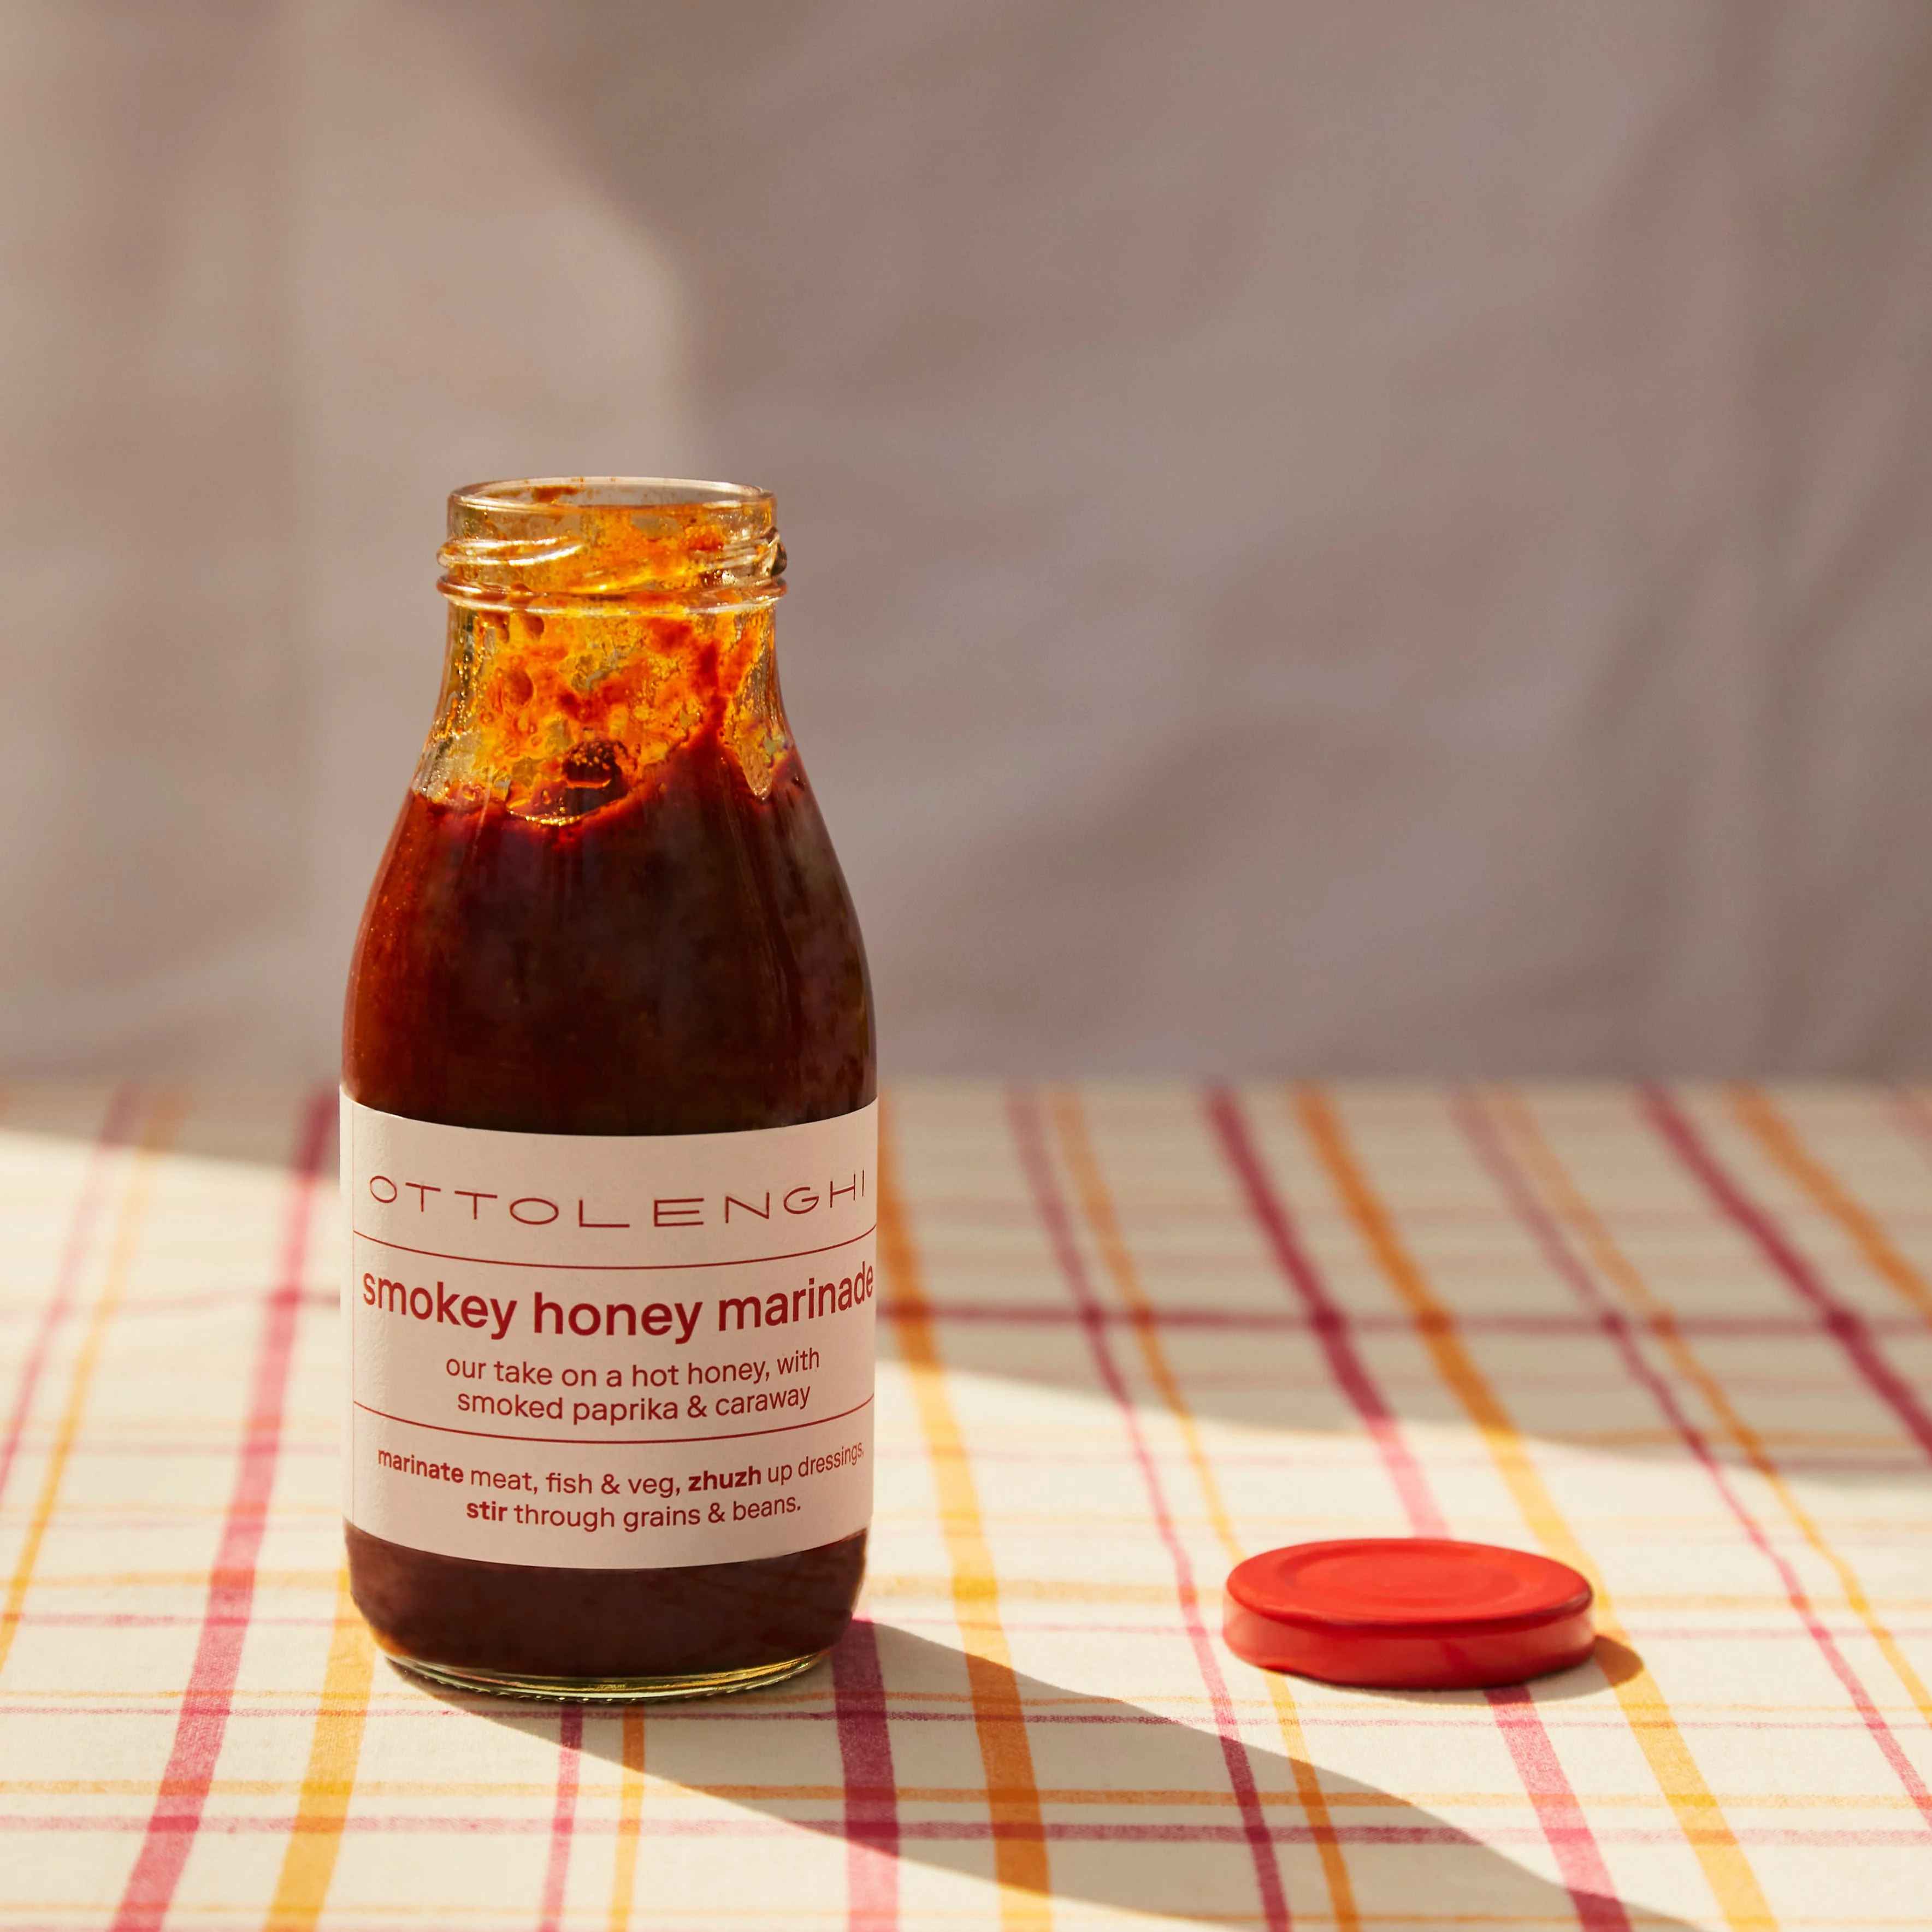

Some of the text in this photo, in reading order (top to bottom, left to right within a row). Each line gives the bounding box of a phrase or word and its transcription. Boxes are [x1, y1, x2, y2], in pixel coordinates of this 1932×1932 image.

[369, 1169, 865, 1228] OTTOLENGHI
[363, 1261, 873, 1345] smokey honey marinade
[446, 1347, 819, 1388] our take on a hot honey, with
[457, 1385, 811, 1426] smoked paprika & caraway
[378, 1449, 464, 1484] marinate
[470, 1469, 538, 1495] meat,
[545, 1472, 593, 1494] fish
[600, 1473, 621, 1495] &
[627, 1477, 681, 1499] veg,
[688, 1465, 761, 1492] zhuzh
[767, 1464, 793, 1486] up
[466, 1496, 801, 1533] stir through grains & beans.
